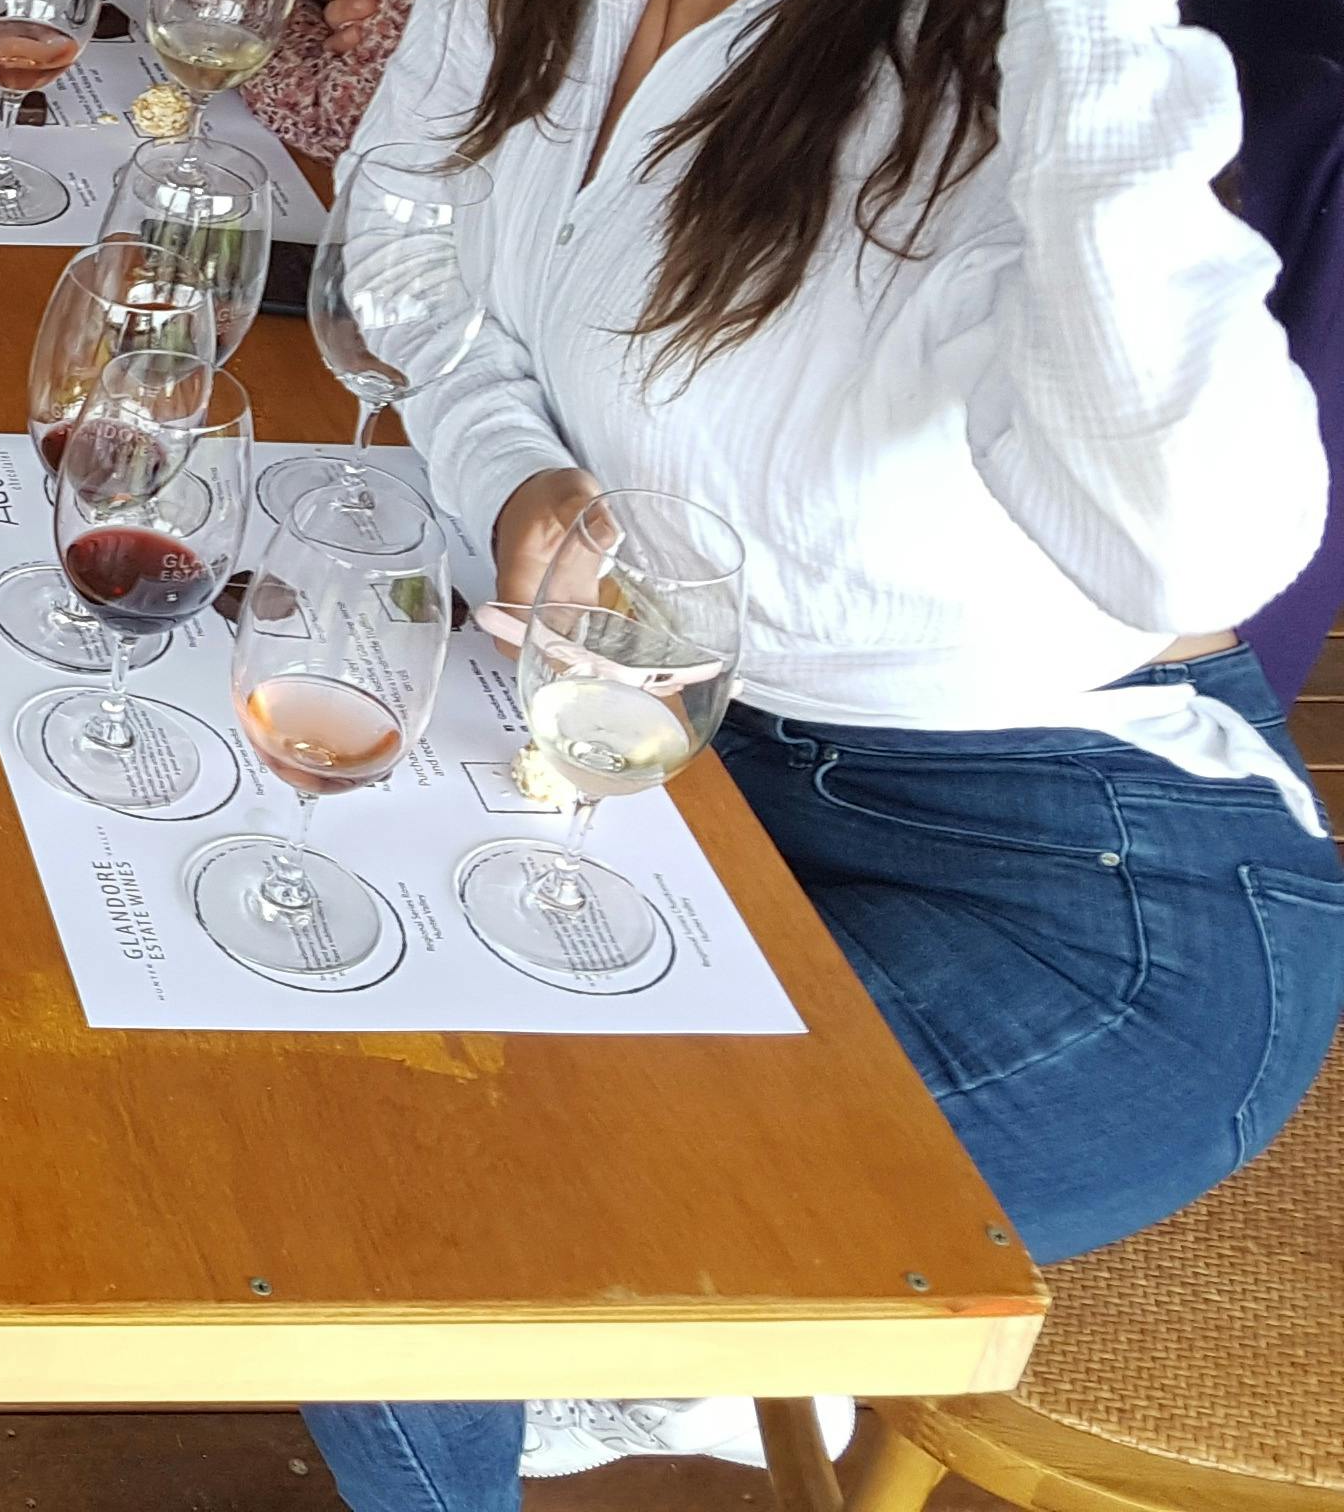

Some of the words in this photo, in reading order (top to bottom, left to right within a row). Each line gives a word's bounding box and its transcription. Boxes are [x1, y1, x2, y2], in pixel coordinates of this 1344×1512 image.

[407, 750, 427, 788] Purchas
[116, 861, 145, 906] WINES
[91, 860, 144, 960] GLANDORE
[133, 911, 165, 960] ESTATE
